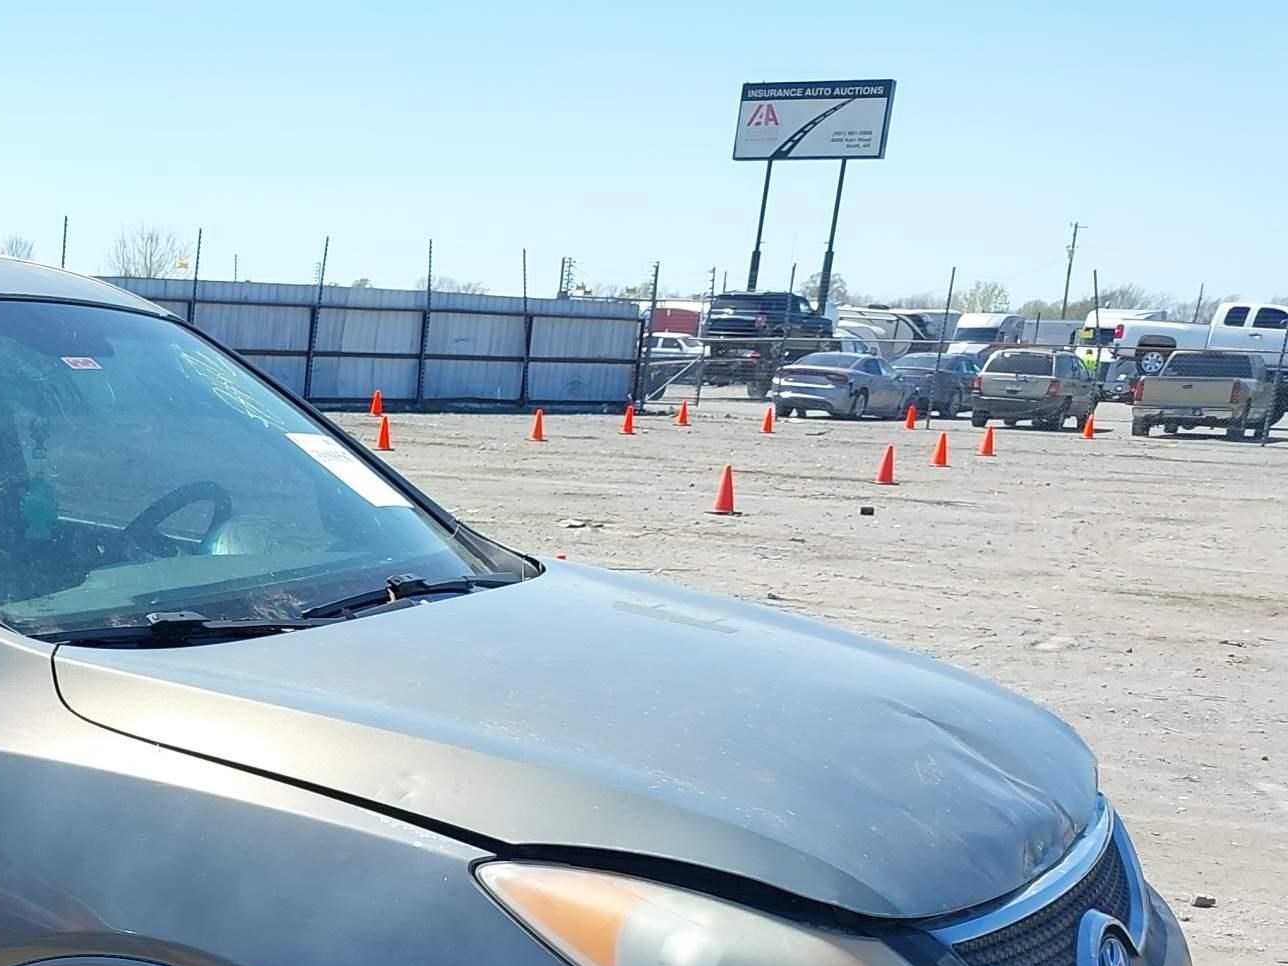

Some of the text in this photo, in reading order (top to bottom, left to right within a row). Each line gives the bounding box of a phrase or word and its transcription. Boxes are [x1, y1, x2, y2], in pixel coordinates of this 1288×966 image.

[747, 85, 884, 98] INSURANCE AUTO AUCTIONS
